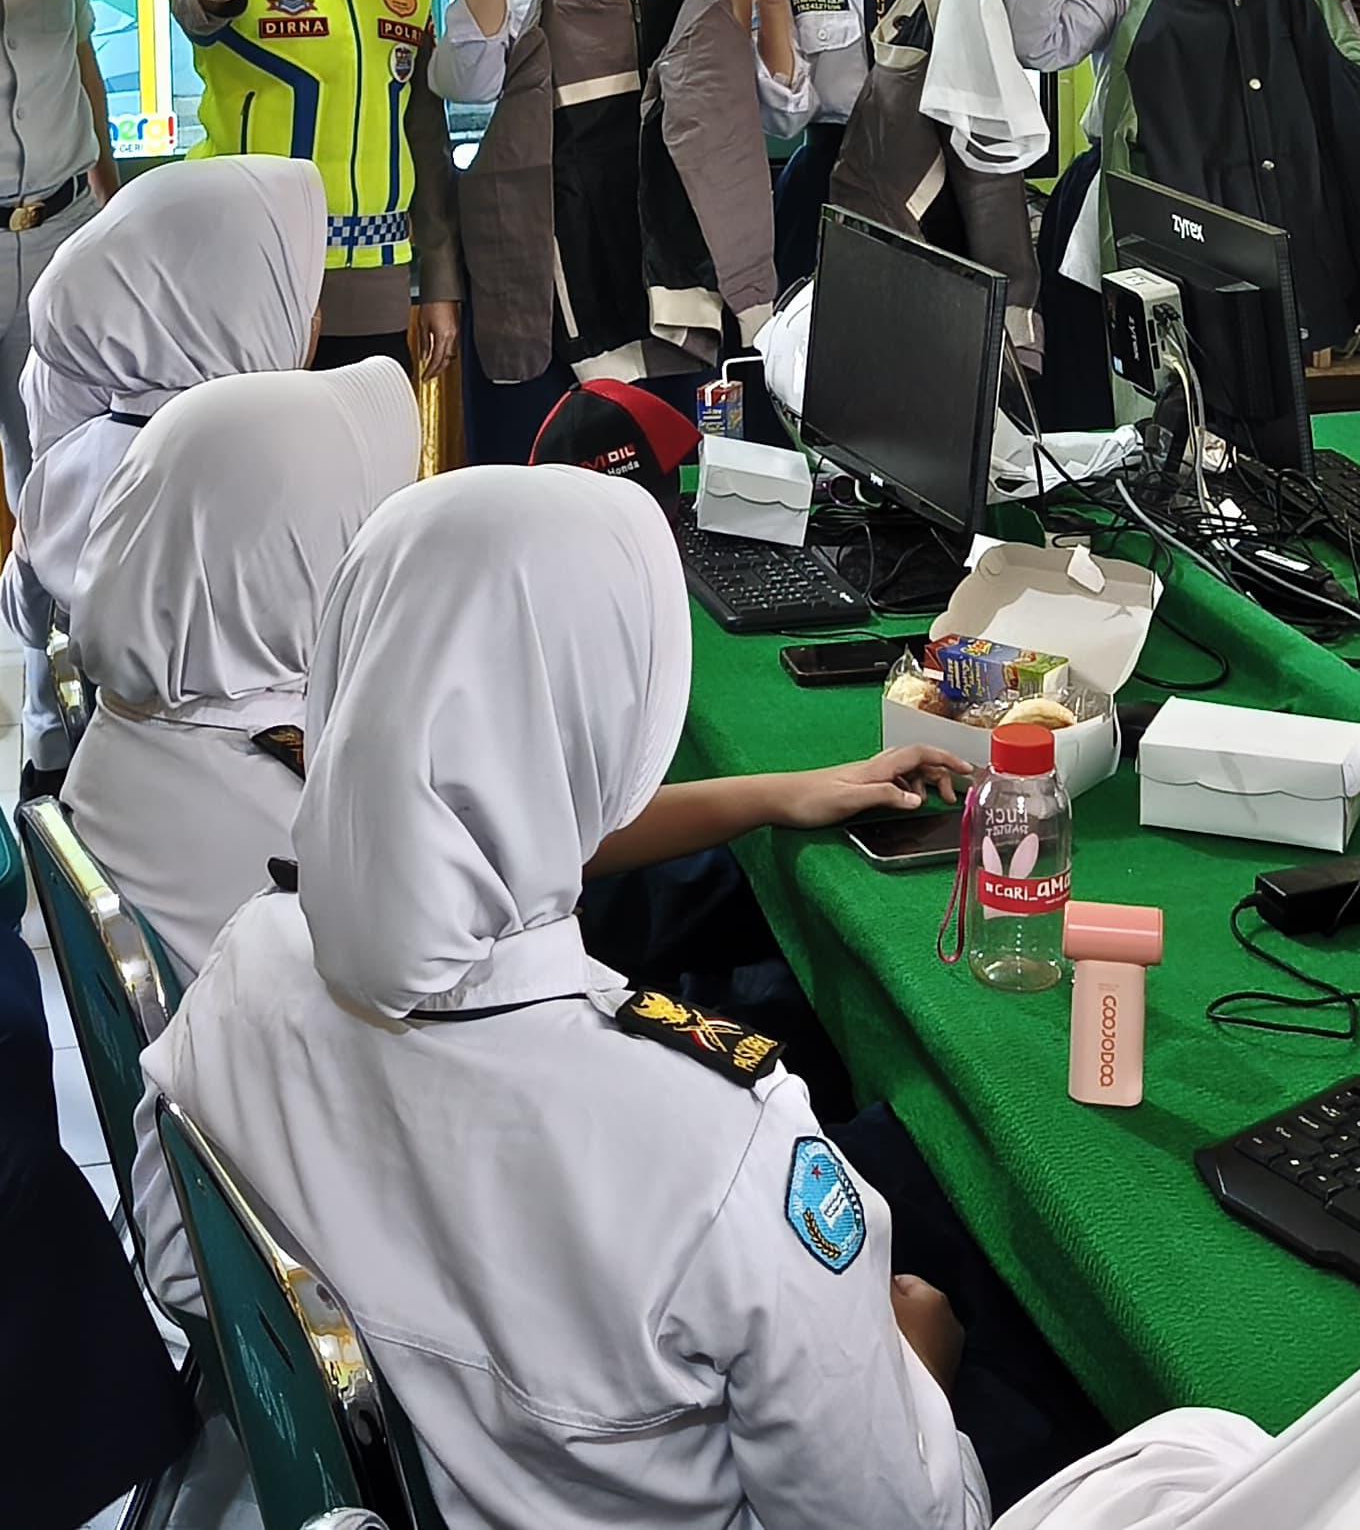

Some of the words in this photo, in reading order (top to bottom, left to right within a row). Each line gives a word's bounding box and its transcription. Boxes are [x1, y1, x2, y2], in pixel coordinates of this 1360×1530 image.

[265, 20, 325, 34] DIRNA
[384, 23, 422, 41] POLRI
[1171, 213, 1205, 243] zyrex
[607, 445, 636, 463] OIL
[1100, 994, 1117, 1086] GOOJODOQ
